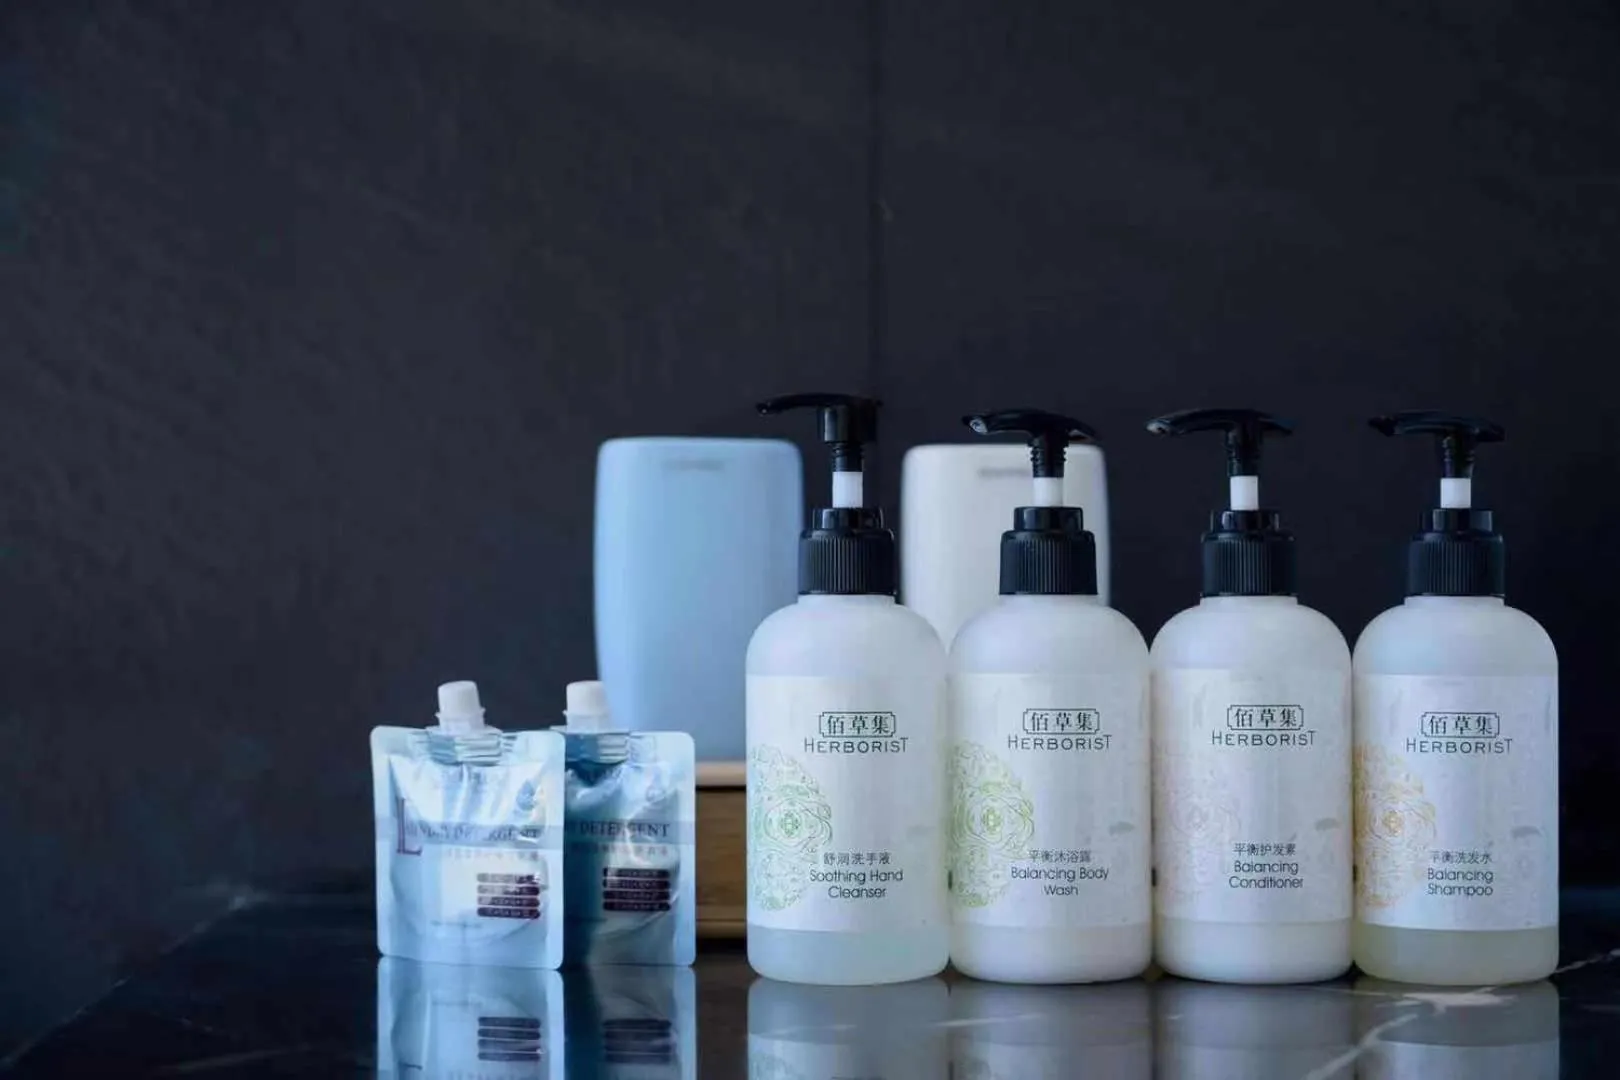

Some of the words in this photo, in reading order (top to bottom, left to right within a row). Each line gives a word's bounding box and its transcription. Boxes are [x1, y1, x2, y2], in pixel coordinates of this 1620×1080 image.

[827, 715, 890, 735] 佰草集
[1031, 711, 1093, 731] 佰草集
[1234, 708, 1297, 728] 佰草集
[1429, 715, 1493, 735] 佰草集
[804, 737, 909, 753] HERBORIST
[1008, 734, 1112, 750] HERBORIST
[1212, 730, 1316, 746] HERBORIST
[1406, 737, 1513, 754] HERBORIST
[1431, 851, 1493, 865] 平衡洗发水
[1011, 867, 1076, 882] Balancing
[1079, 867, 1109, 881] Body
[1234, 860, 1299, 875] Balancing
[809, 869, 866, 885] Soothing
[870, 869, 904, 882] Hand
[1229, 876, 1303, 889] Conditioner
[1427, 868, 1494, 884] Balancing
[828, 885, 887, 899] Cleanser
[1044, 884, 1079, 896] Wash
[1427, 884, 1494, 898] Shampoo
